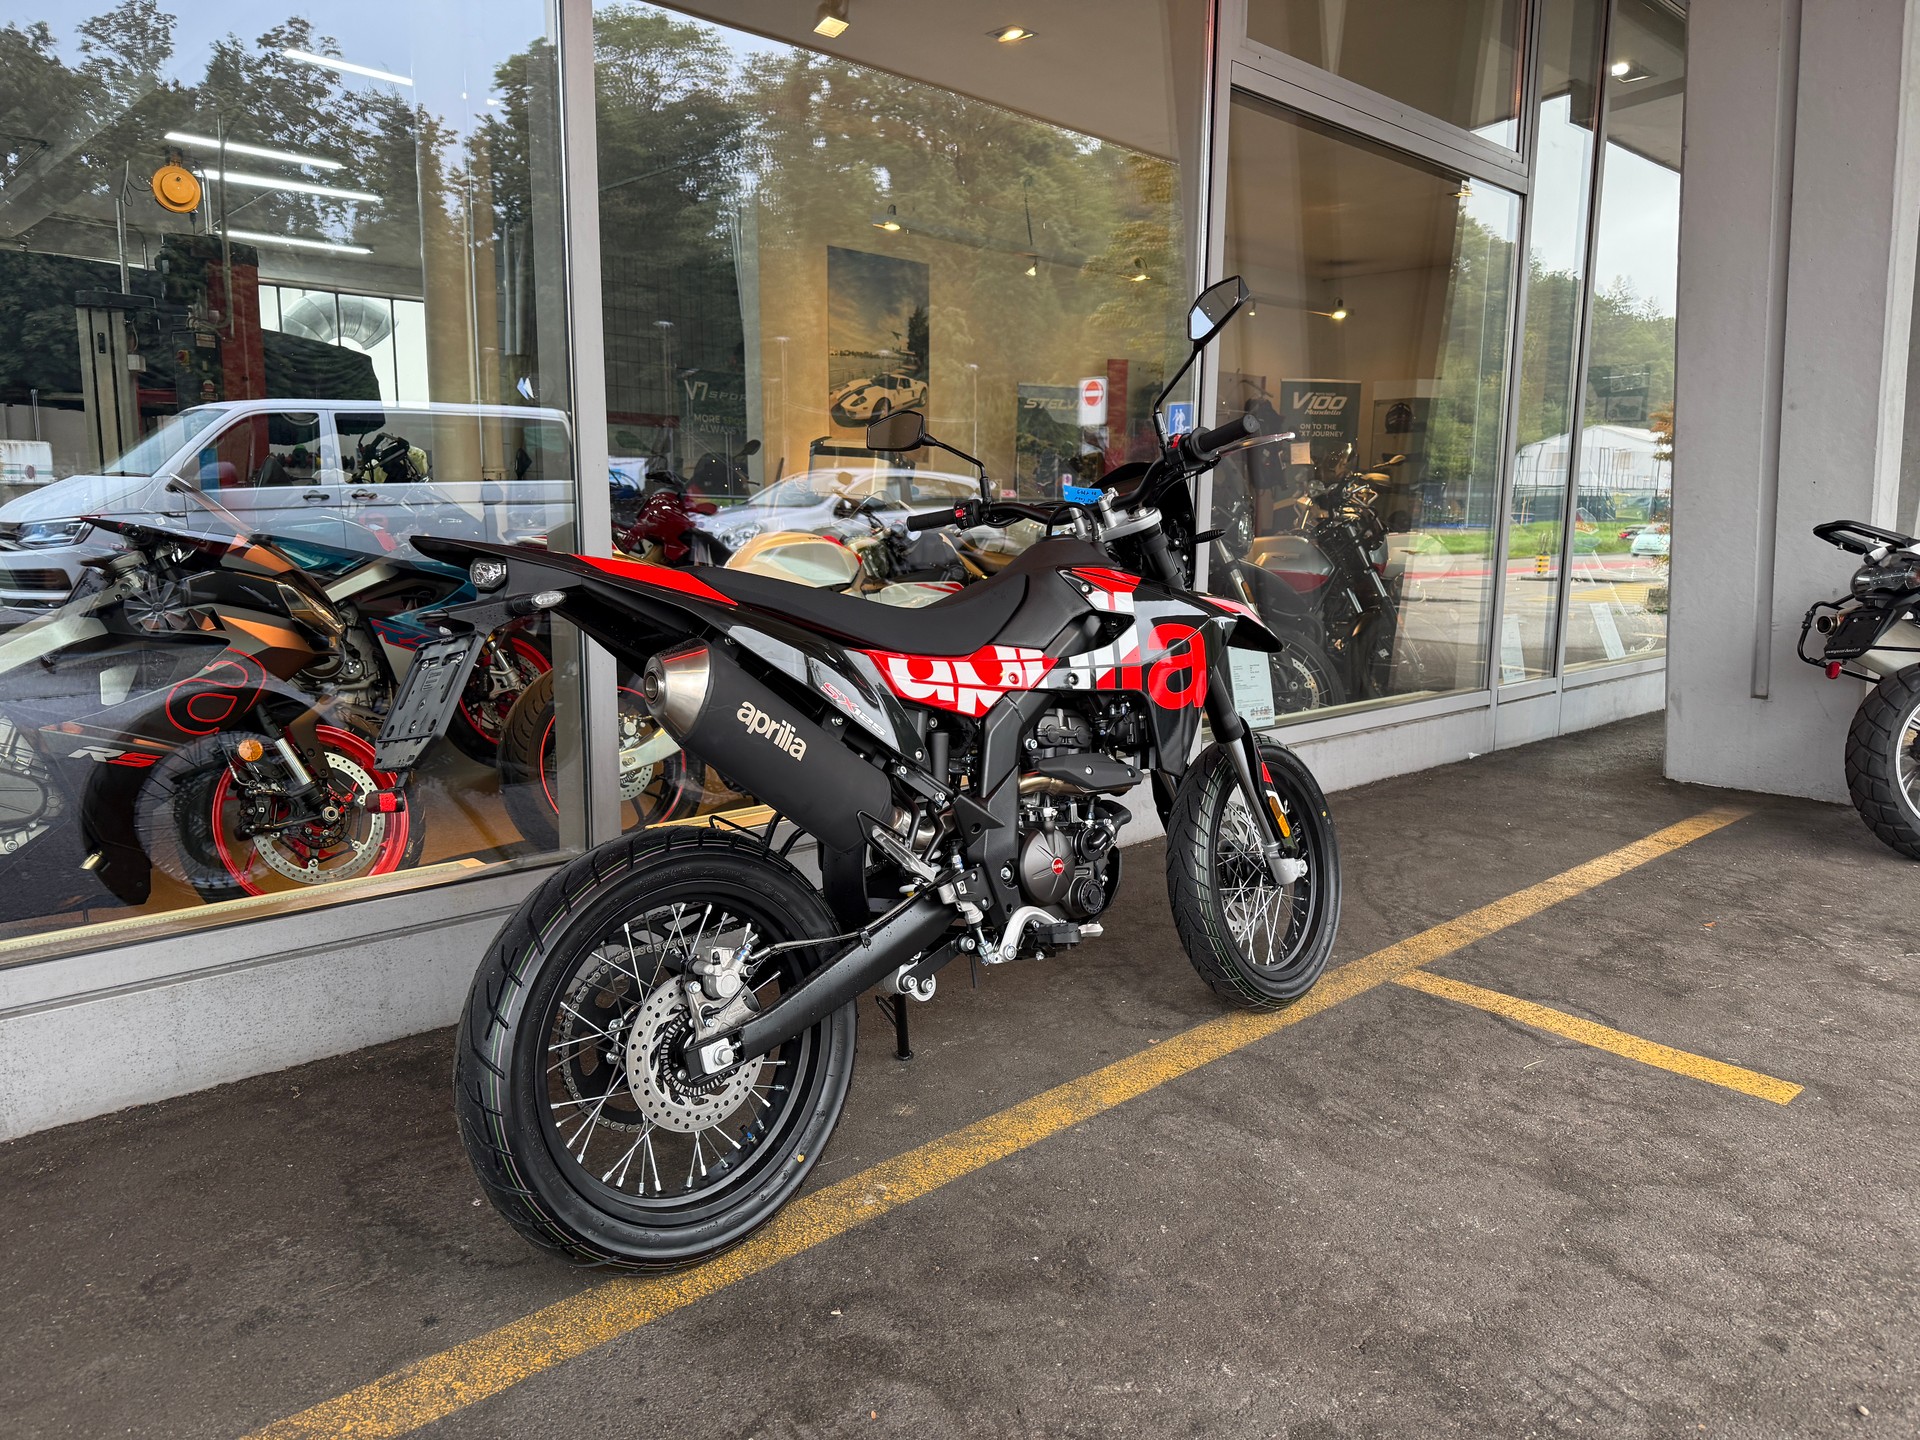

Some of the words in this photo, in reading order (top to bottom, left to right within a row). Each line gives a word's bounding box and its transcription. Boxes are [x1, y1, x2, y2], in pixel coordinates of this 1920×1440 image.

[684, 380, 709, 401] V7
[709, 391, 747, 401] SPOR
[1293, 392, 1348, 410] V100
[694, 414, 721, 424] MORE
[736, 701, 807, 761] aprilia
[68, 745, 164, 768] RS
